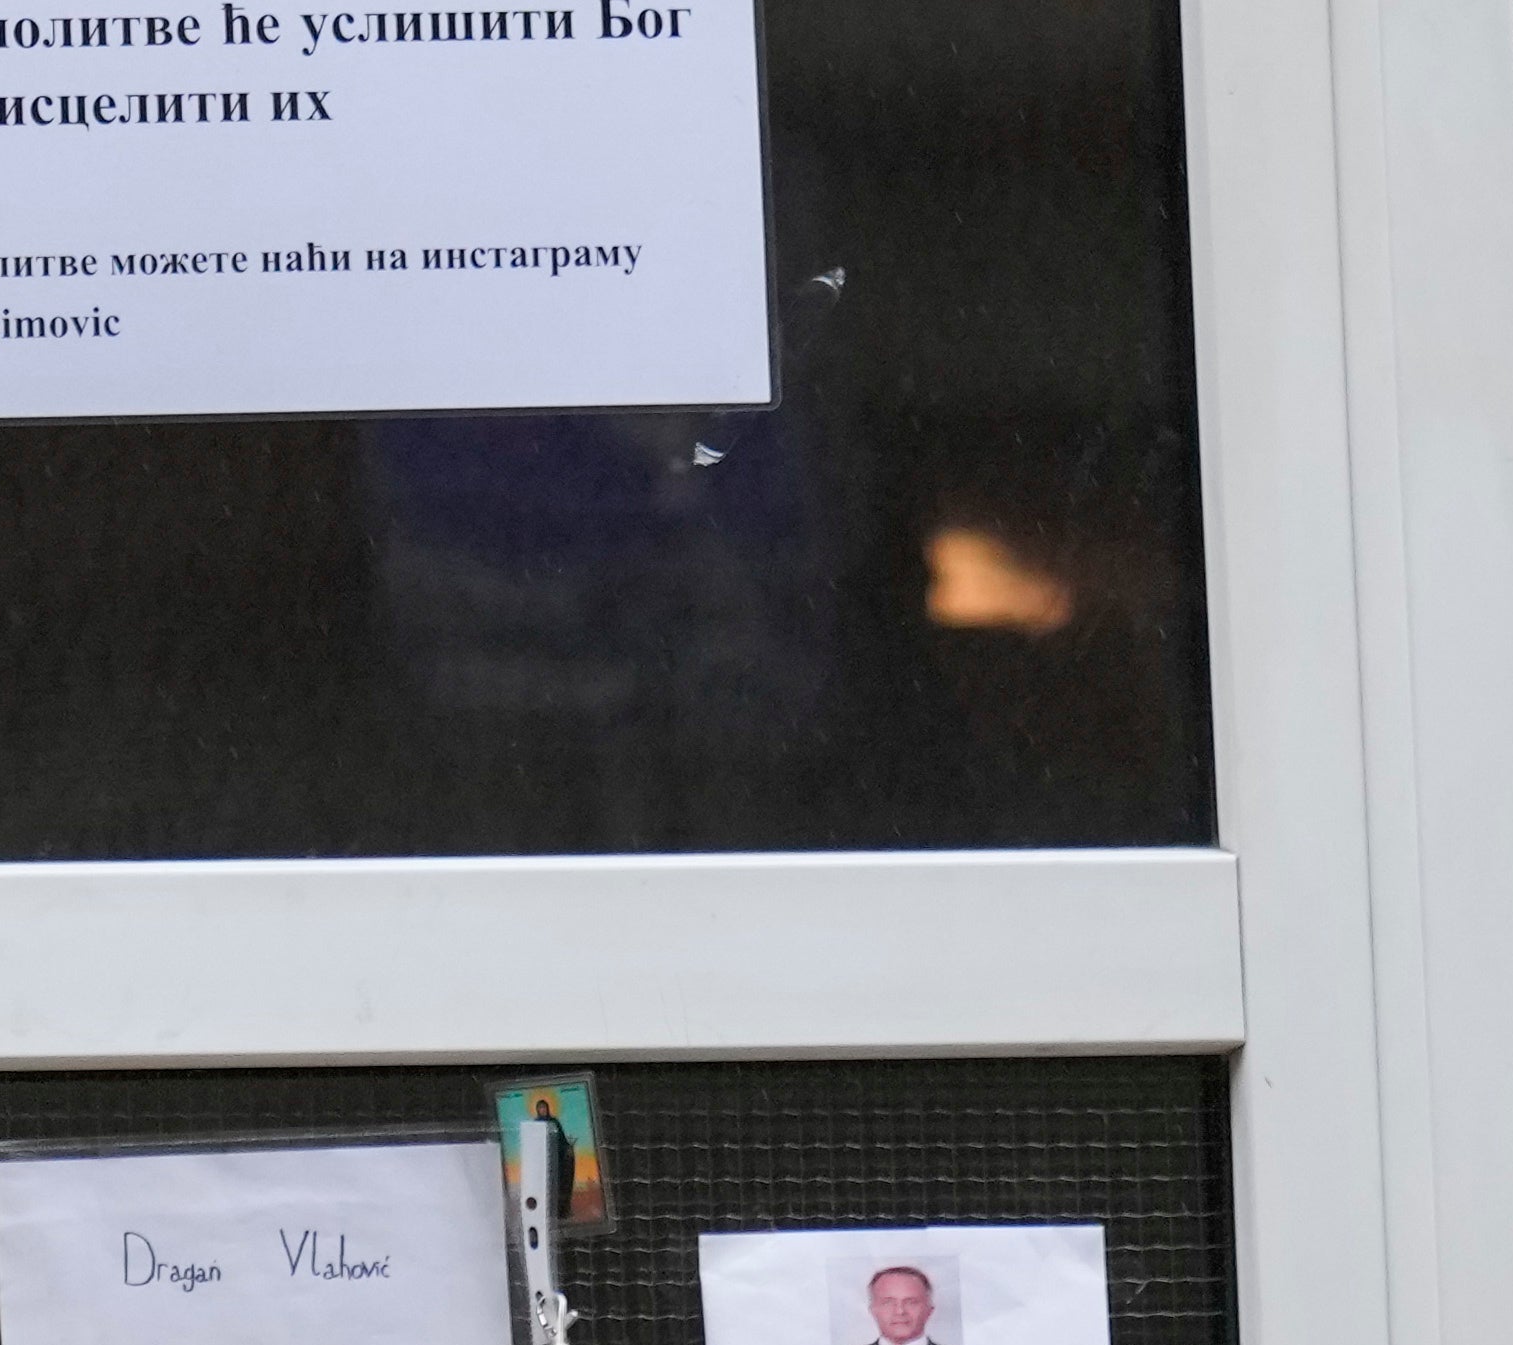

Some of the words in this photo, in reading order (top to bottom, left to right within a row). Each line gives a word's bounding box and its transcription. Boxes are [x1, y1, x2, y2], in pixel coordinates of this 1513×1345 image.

[222, 2, 279, 45] ће
[300, 10, 573, 57] услишити
[271, 91, 331, 122] их
[111, 252, 247, 275] можете
[261, 241, 350, 273] наћи
[366, 249, 408, 271] на
[422, 245, 641, 277] инстаграму
